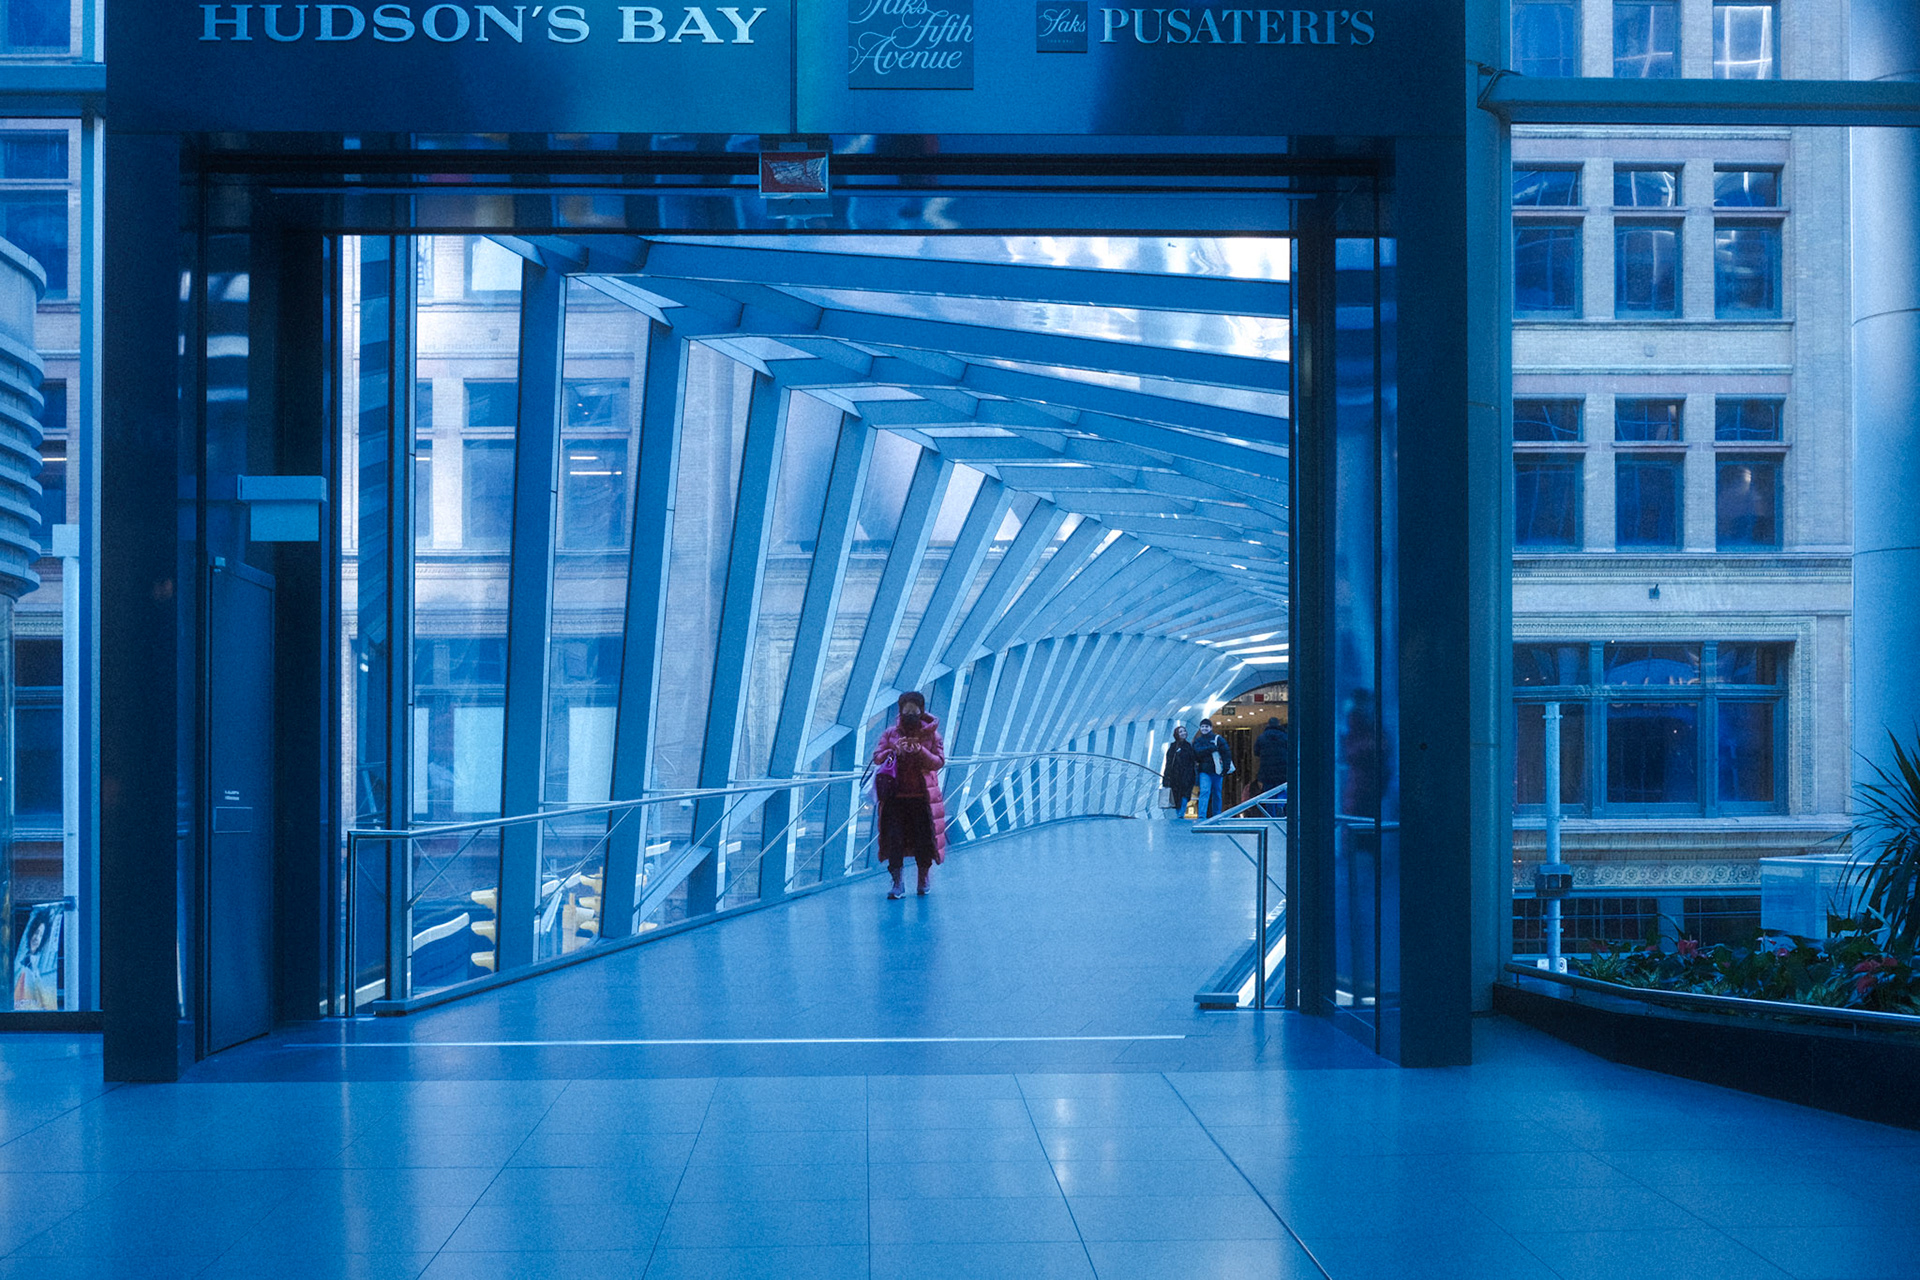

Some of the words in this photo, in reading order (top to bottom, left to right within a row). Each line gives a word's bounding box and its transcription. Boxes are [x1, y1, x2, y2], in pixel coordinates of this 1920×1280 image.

[199, 3, 590, 43] HUDSON'S
[617, 6, 767, 43] BAY
[891, 9, 974, 50] Fifth
[1038, 8, 1086, 37] Saks
[1099, 8, 1375, 46] PUSATERI'S
[848, 31, 963, 75] Avenue
